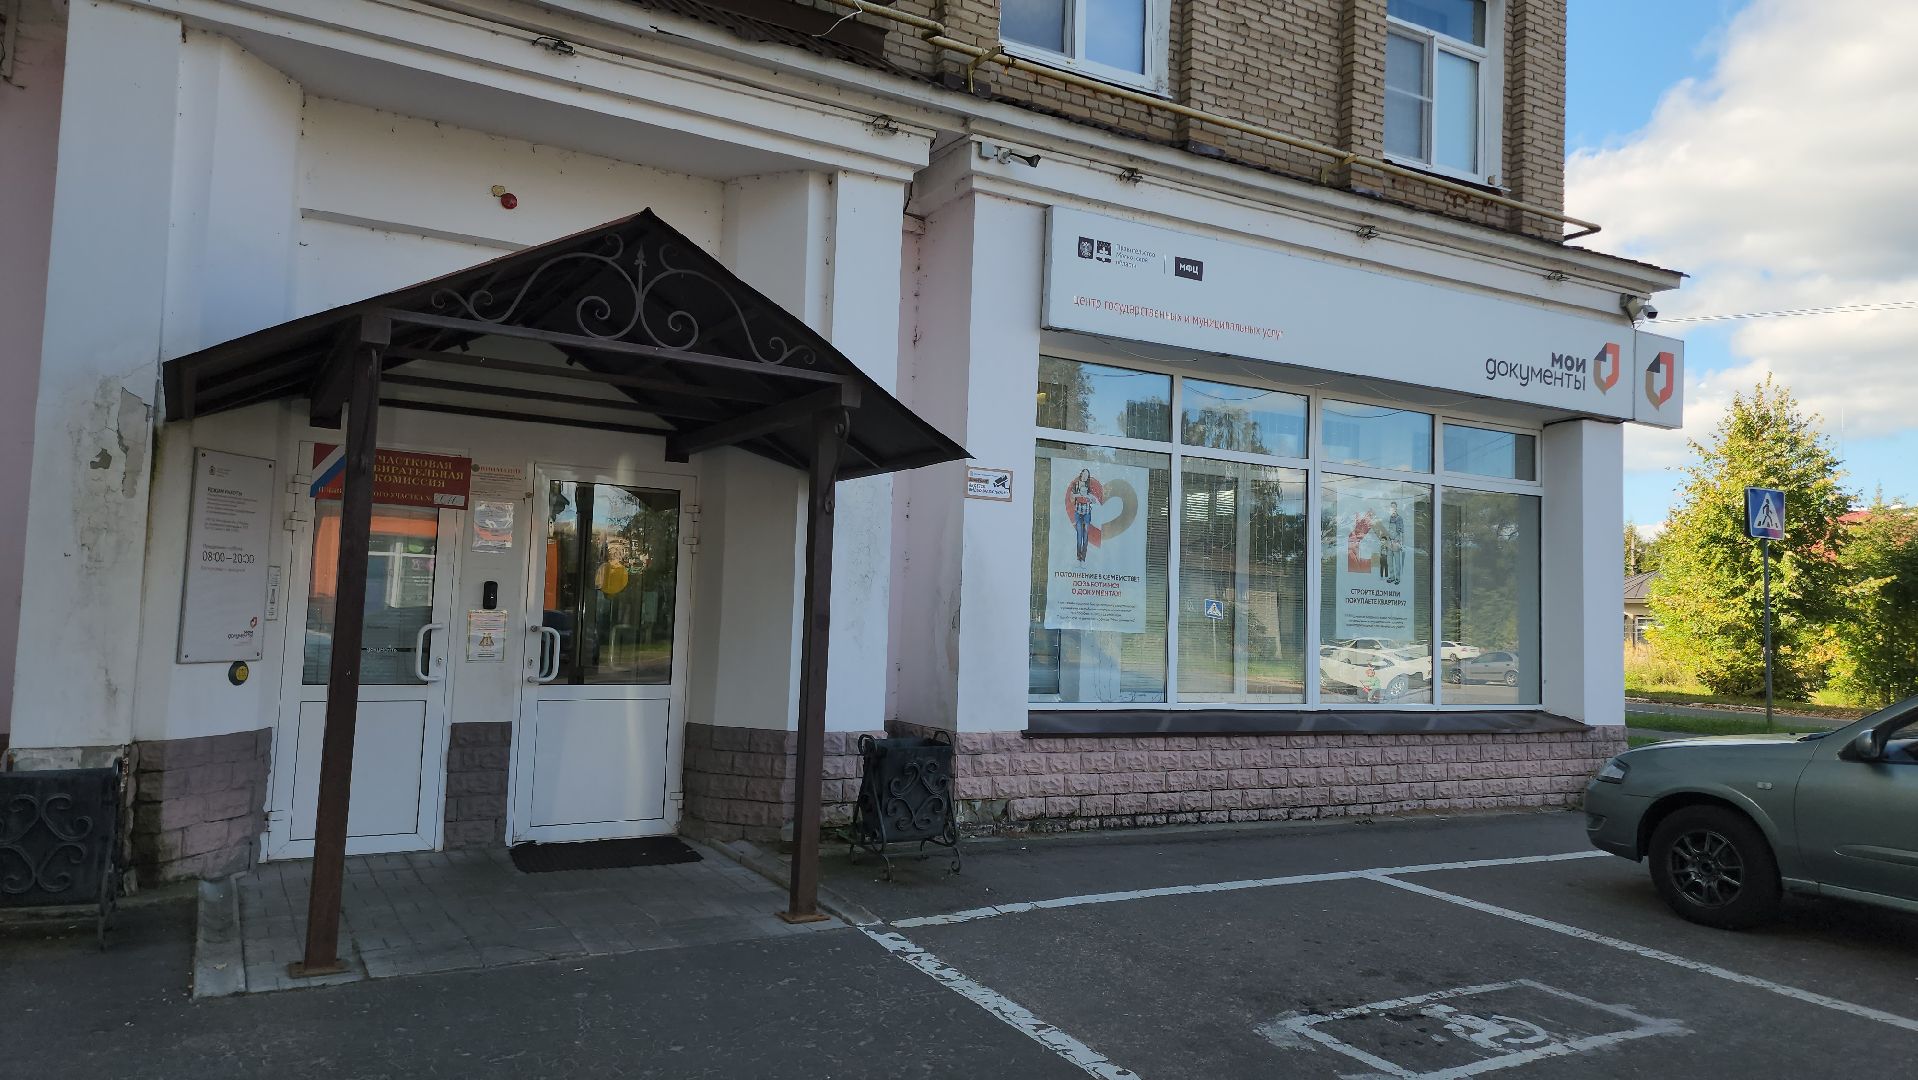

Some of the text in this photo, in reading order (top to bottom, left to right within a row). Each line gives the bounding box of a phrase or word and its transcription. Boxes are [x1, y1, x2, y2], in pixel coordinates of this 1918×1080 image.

[1179, 262, 1199, 275] МФЦ
[1073, 295, 1101, 310] центр
[1104, 300, 1182, 321] государственных
[1184, 315, 1190, 323] и
[1192, 315, 1261, 335] муниципальных
[1485, 357, 1587, 391] документы
[377, 455, 453, 470] ЧАСТКОВАЯ
[373, 464, 465, 481] БИРАТЕЛЬНАЯ
[374, 473, 446, 488] КОМИССИЯ
